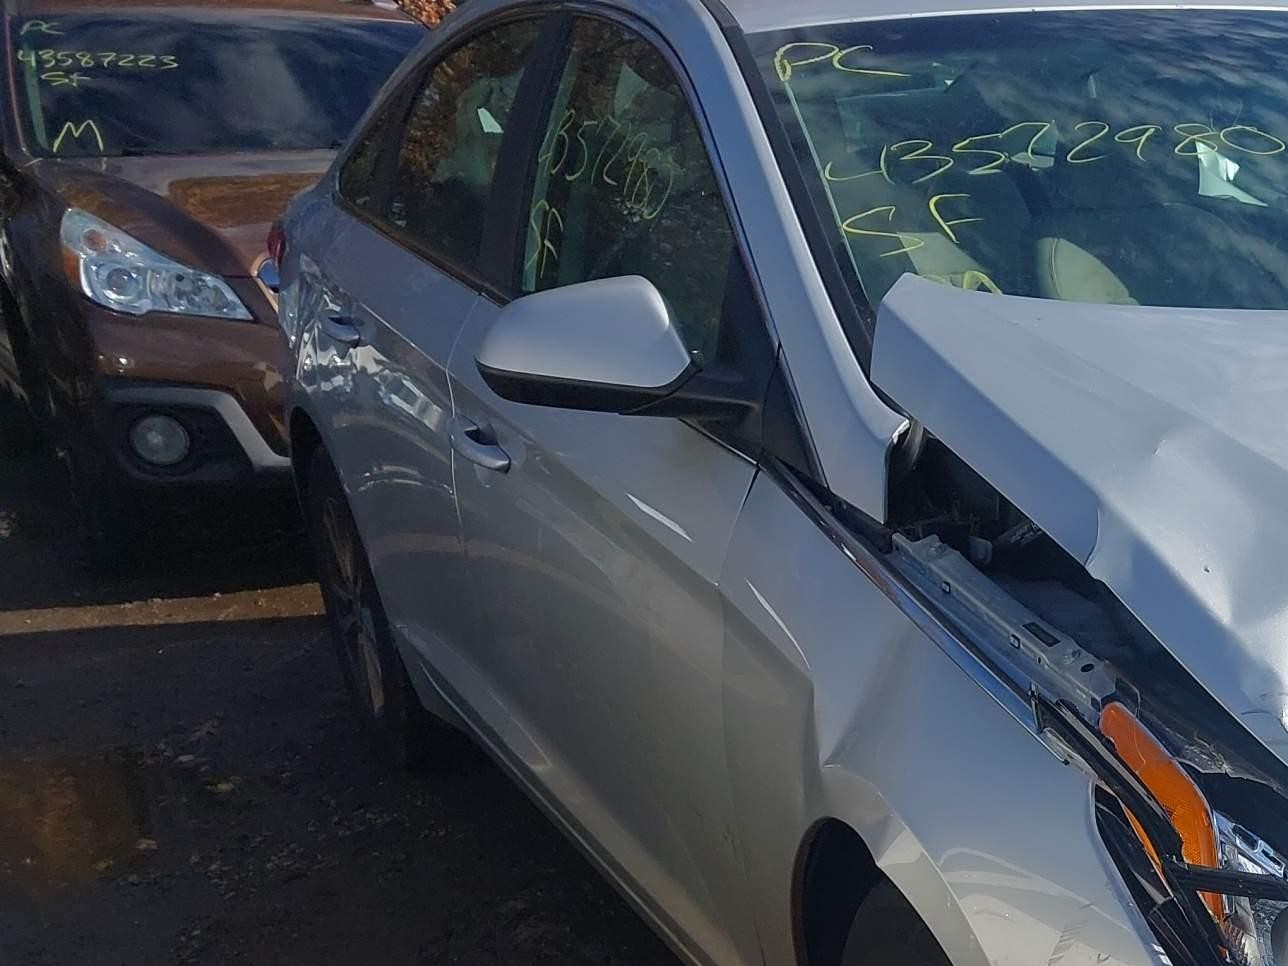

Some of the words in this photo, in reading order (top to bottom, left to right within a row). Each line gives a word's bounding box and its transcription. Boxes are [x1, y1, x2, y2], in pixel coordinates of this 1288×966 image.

[17, 49, 180, 70] 43587223
[773, 42, 911, 81] PC
[53, 119, 104, 153] M
[824, 121, 1286, 185] 43572980
